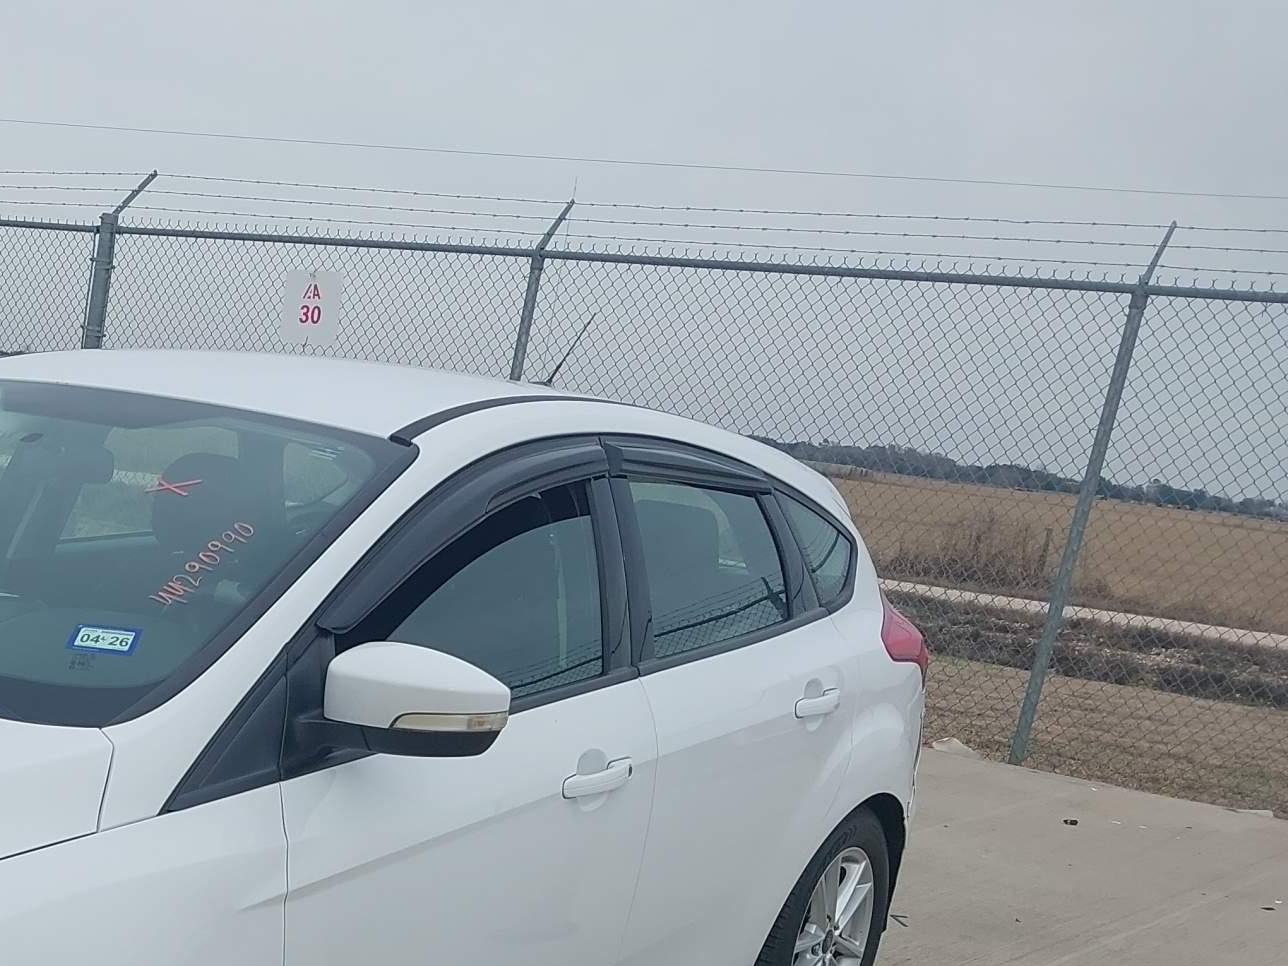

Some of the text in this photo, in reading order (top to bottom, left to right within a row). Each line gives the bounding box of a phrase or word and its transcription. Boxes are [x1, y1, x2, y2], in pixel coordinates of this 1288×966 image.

[298, 304, 322, 325] 30
[147, 521, 255, 605] 44290990
[79, 633, 101, 645] 04
[107, 635, 131, 648] 26
